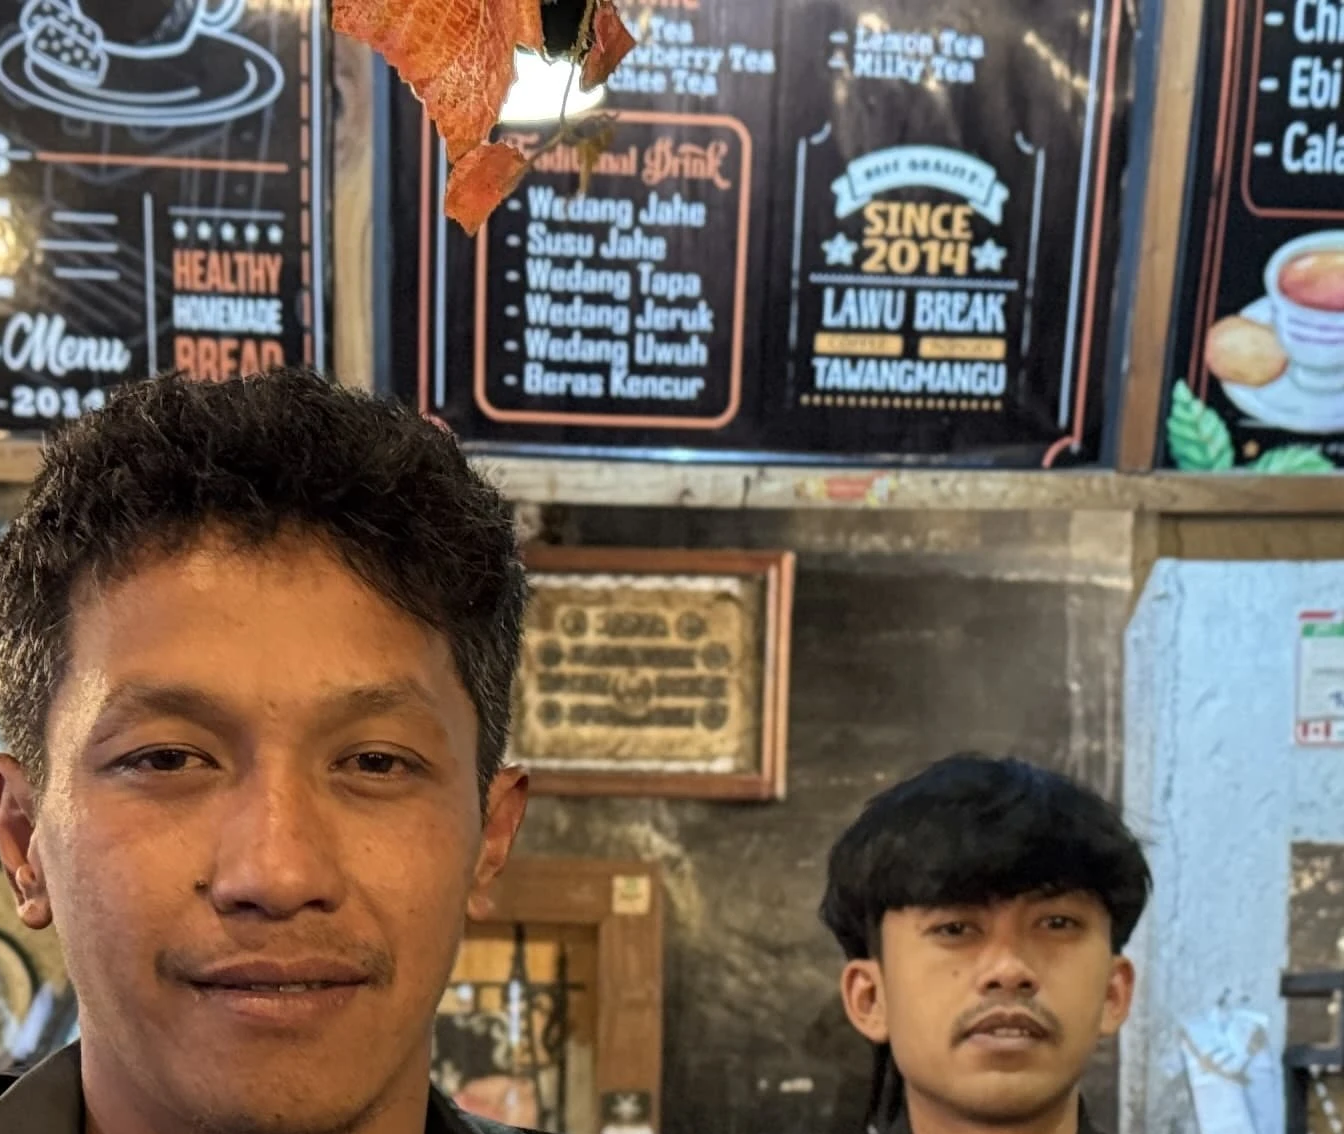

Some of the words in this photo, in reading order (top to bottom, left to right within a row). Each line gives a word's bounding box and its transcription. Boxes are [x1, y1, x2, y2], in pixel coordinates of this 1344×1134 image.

[729, 44, 776, 74] Tea
[854, 24, 935, 53] Lemon
[939, 28, 984, 59] Tea
[607, 68, 666, 94] chee
[672, 69, 718, 96] Tea
[854, 51, 925, 84] Milky
[931, 54, 975, 84] Tea
[1288, 55, 1344, 109] Ebi
[642, 137, 731, 189] Drink
[527, 186, 633, 229] Wedang
[639, 191, 706, 227] Jahe
[863, 201, 973, 239] SINCE
[527, 221, 594, 258] Susu
[600, 226, 667, 261] Jahe
[861, 238, 969, 276] 2014
[173, 249, 283, 294] HEALTHY
[526, 258, 631, 300] Wedang
[173, 294, 283, 334] HOMEMADE
[525, 293, 630, 334] Wedang
[635, 298, 714, 332] Jeruk
[822, 286, 906, 330] LAWU
[913, 289, 1006, 332] BREAK
[3, 313, 131, 376] Menu
[174, 335, 285, 384] BREAD
[524, 328, 629, 368] Wedang
[635, 332, 708, 366] Uwuh
[524, 362, 603, 397] Beras
[609, 367, 705, 400] Kencur
[812, 356, 1006, 396] TAWANGMANGU
